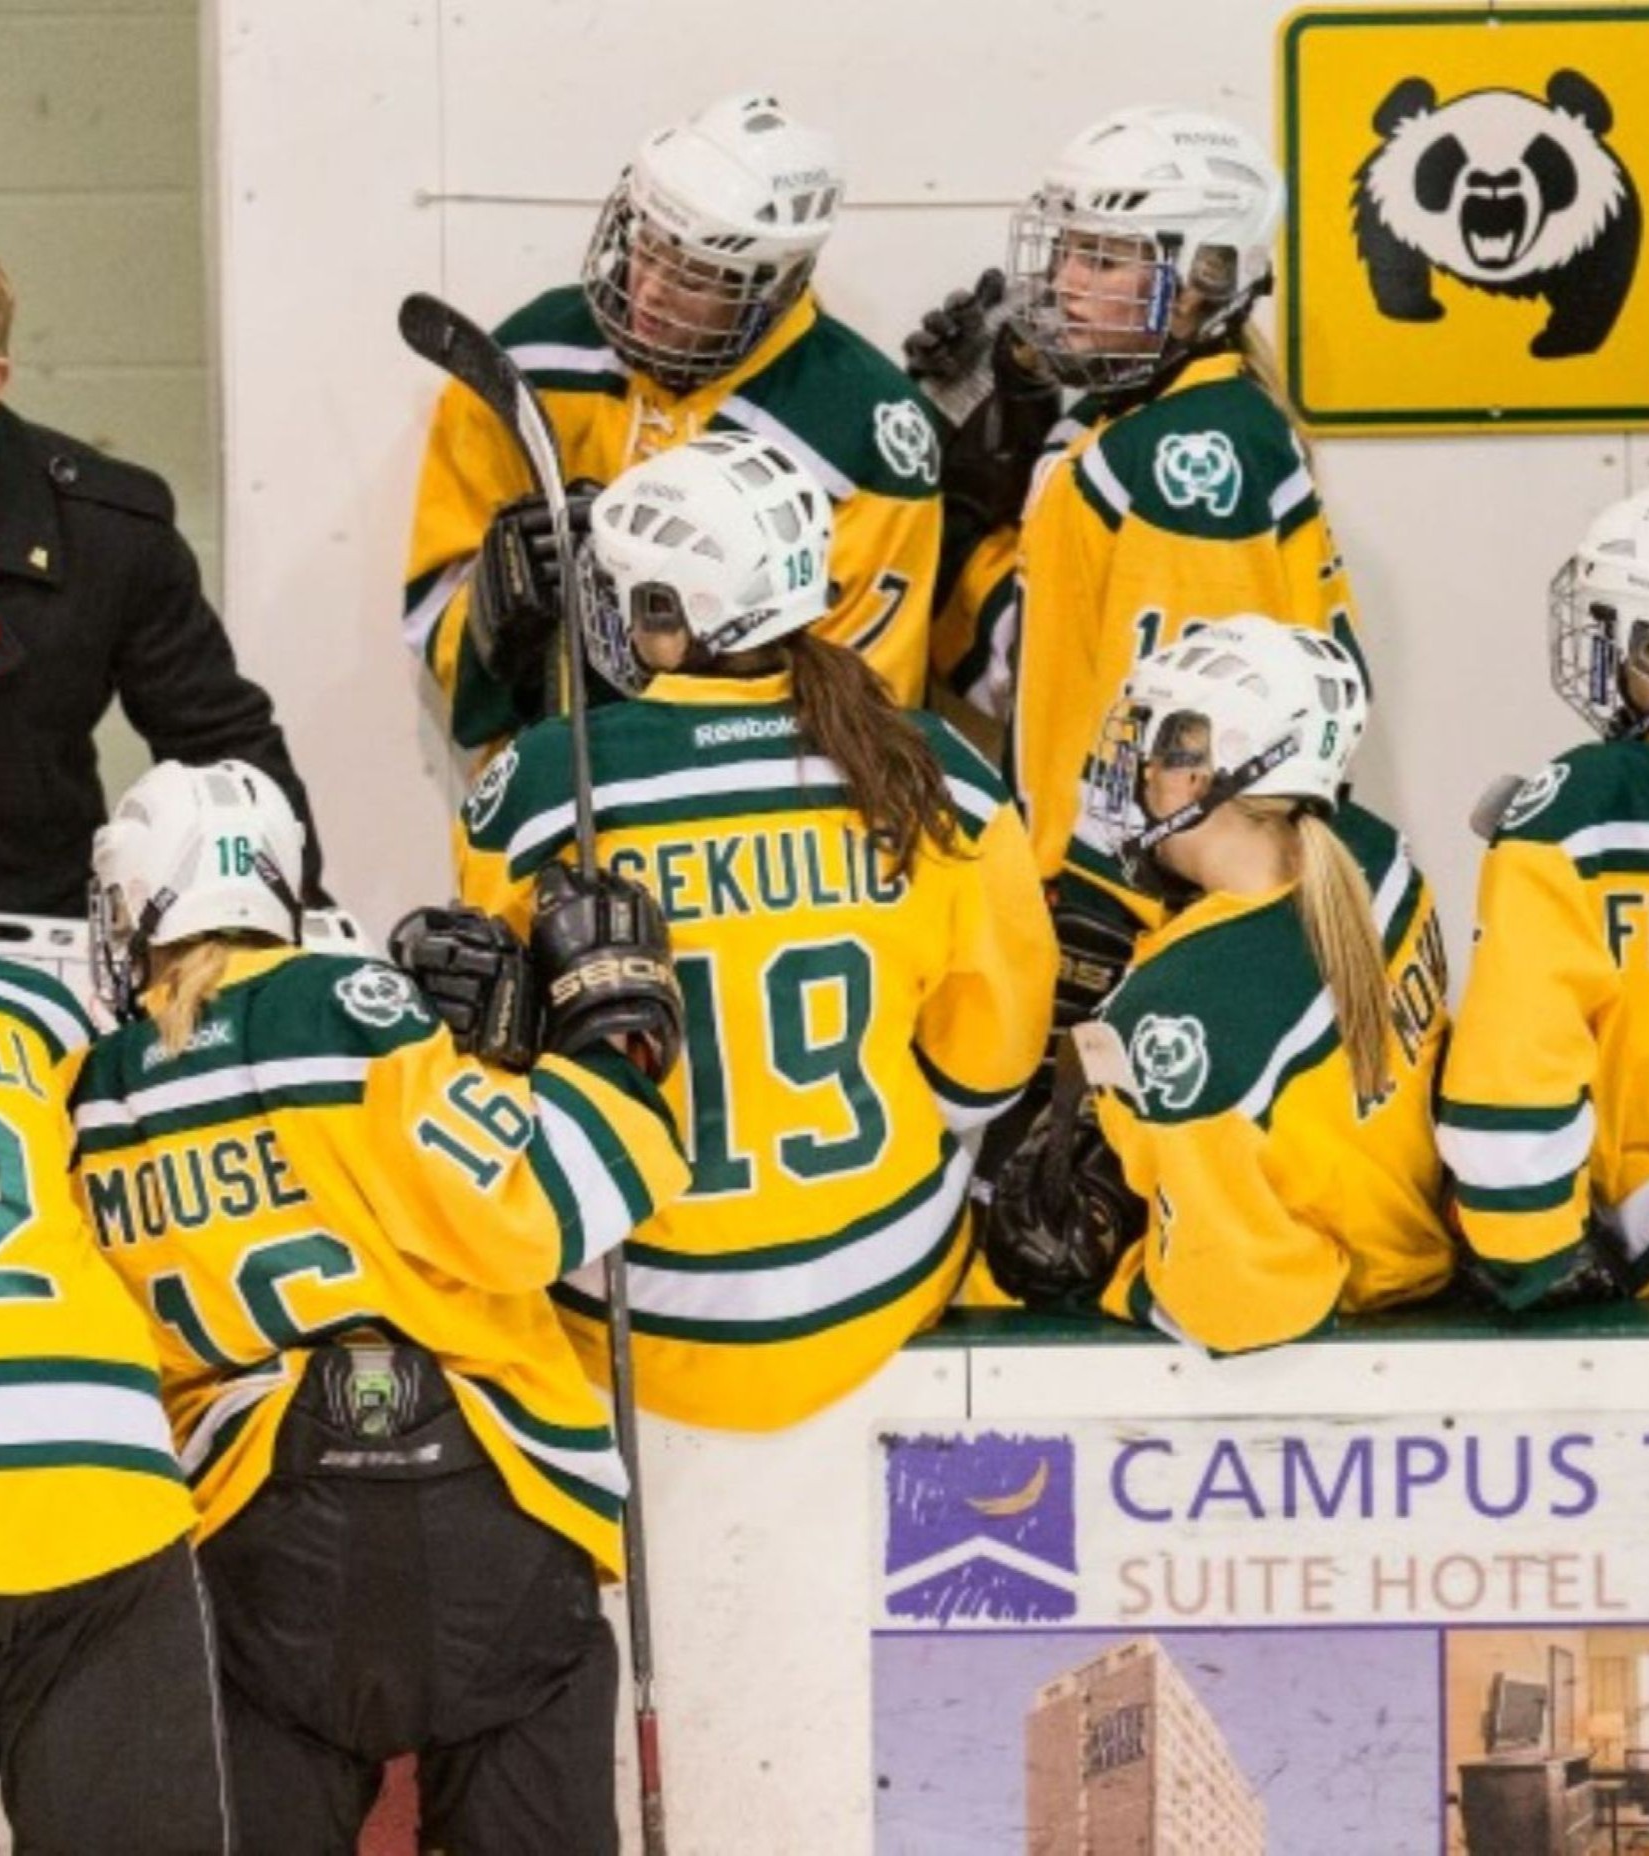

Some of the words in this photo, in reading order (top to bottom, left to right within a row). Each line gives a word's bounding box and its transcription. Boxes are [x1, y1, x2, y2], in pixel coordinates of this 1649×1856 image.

[785, 548, 814, 591] 19
[693, 715, 798, 749] Reebok
[216, 835, 252, 876] 16
[676, 938, 888, 1195] 19
[417, 1072, 533, 1189] 16
[1109, 1434, 1600, 1522] CAMPUS
[1116, 1555, 1336, 1616] SUITE
[1371, 1553, 1628, 1613] HOTEL
